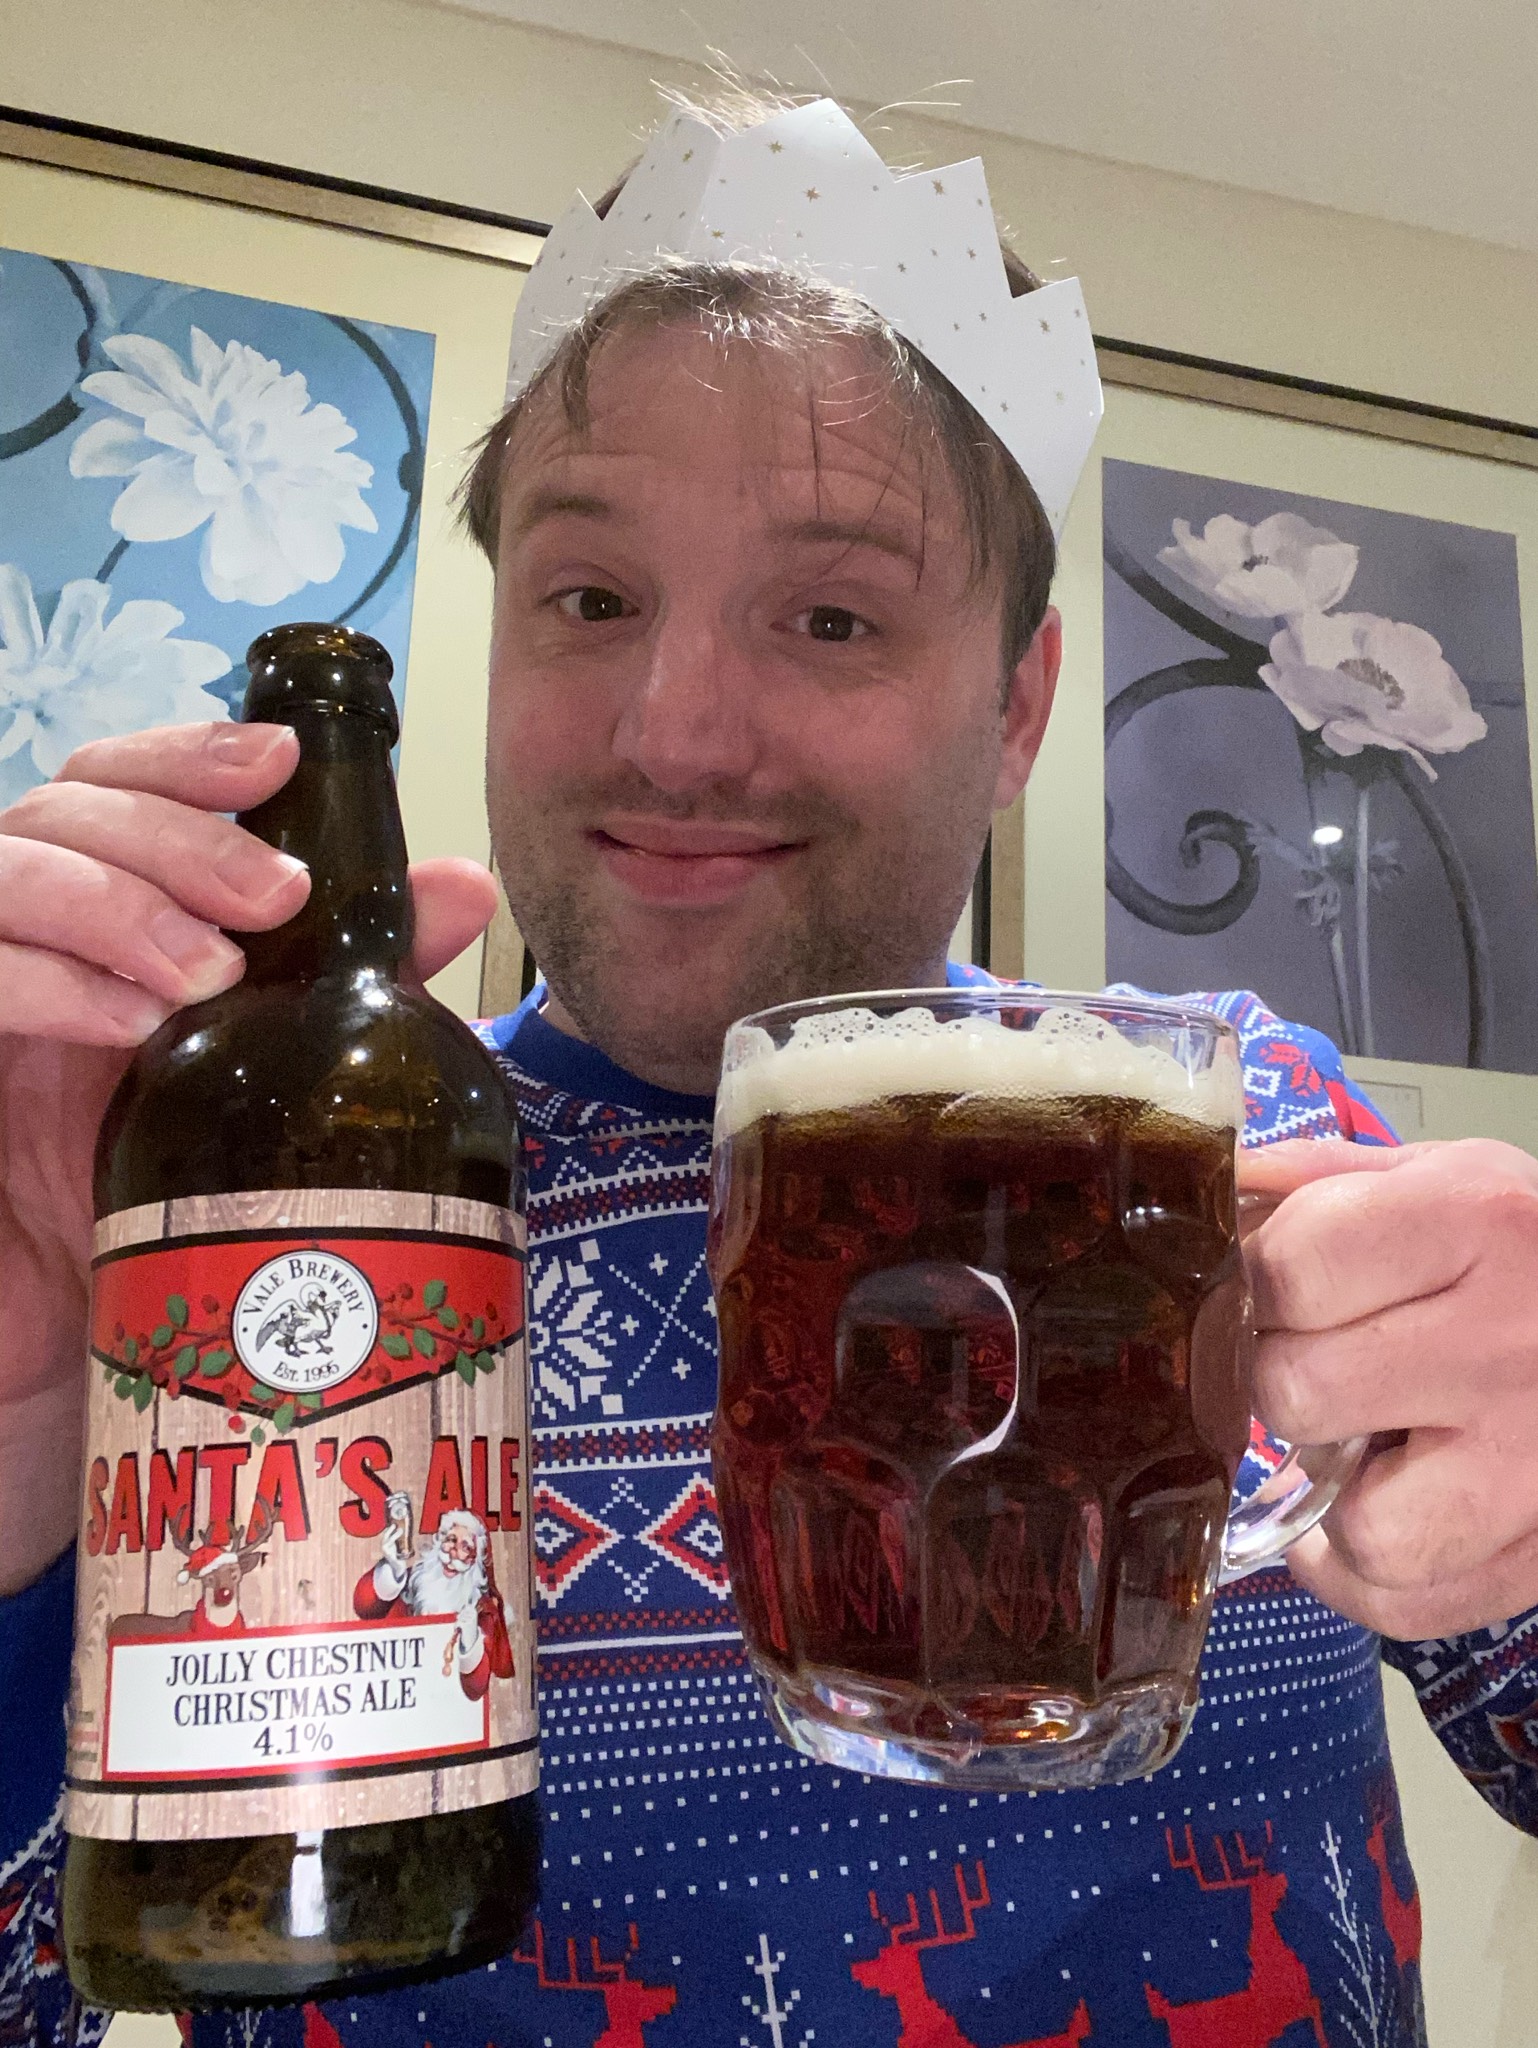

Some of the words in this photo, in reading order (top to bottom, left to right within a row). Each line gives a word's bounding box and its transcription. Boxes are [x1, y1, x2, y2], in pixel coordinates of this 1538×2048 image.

[242, 1271, 285, 1314] VALE
[288, 1258, 365, 1312] BREWERY
[87, 1435, 396, 1556] SANTA'S
[418, 1435, 521, 1535] ALE
[166, 1650, 257, 1687] JOLLY
[265, 1637, 426, 1680] CHESTNUT
[173, 1684, 352, 1727] CHRISTMAS
[360, 1678, 417, 1713] ALE
[253, 1722, 334, 1757] 4.1%
